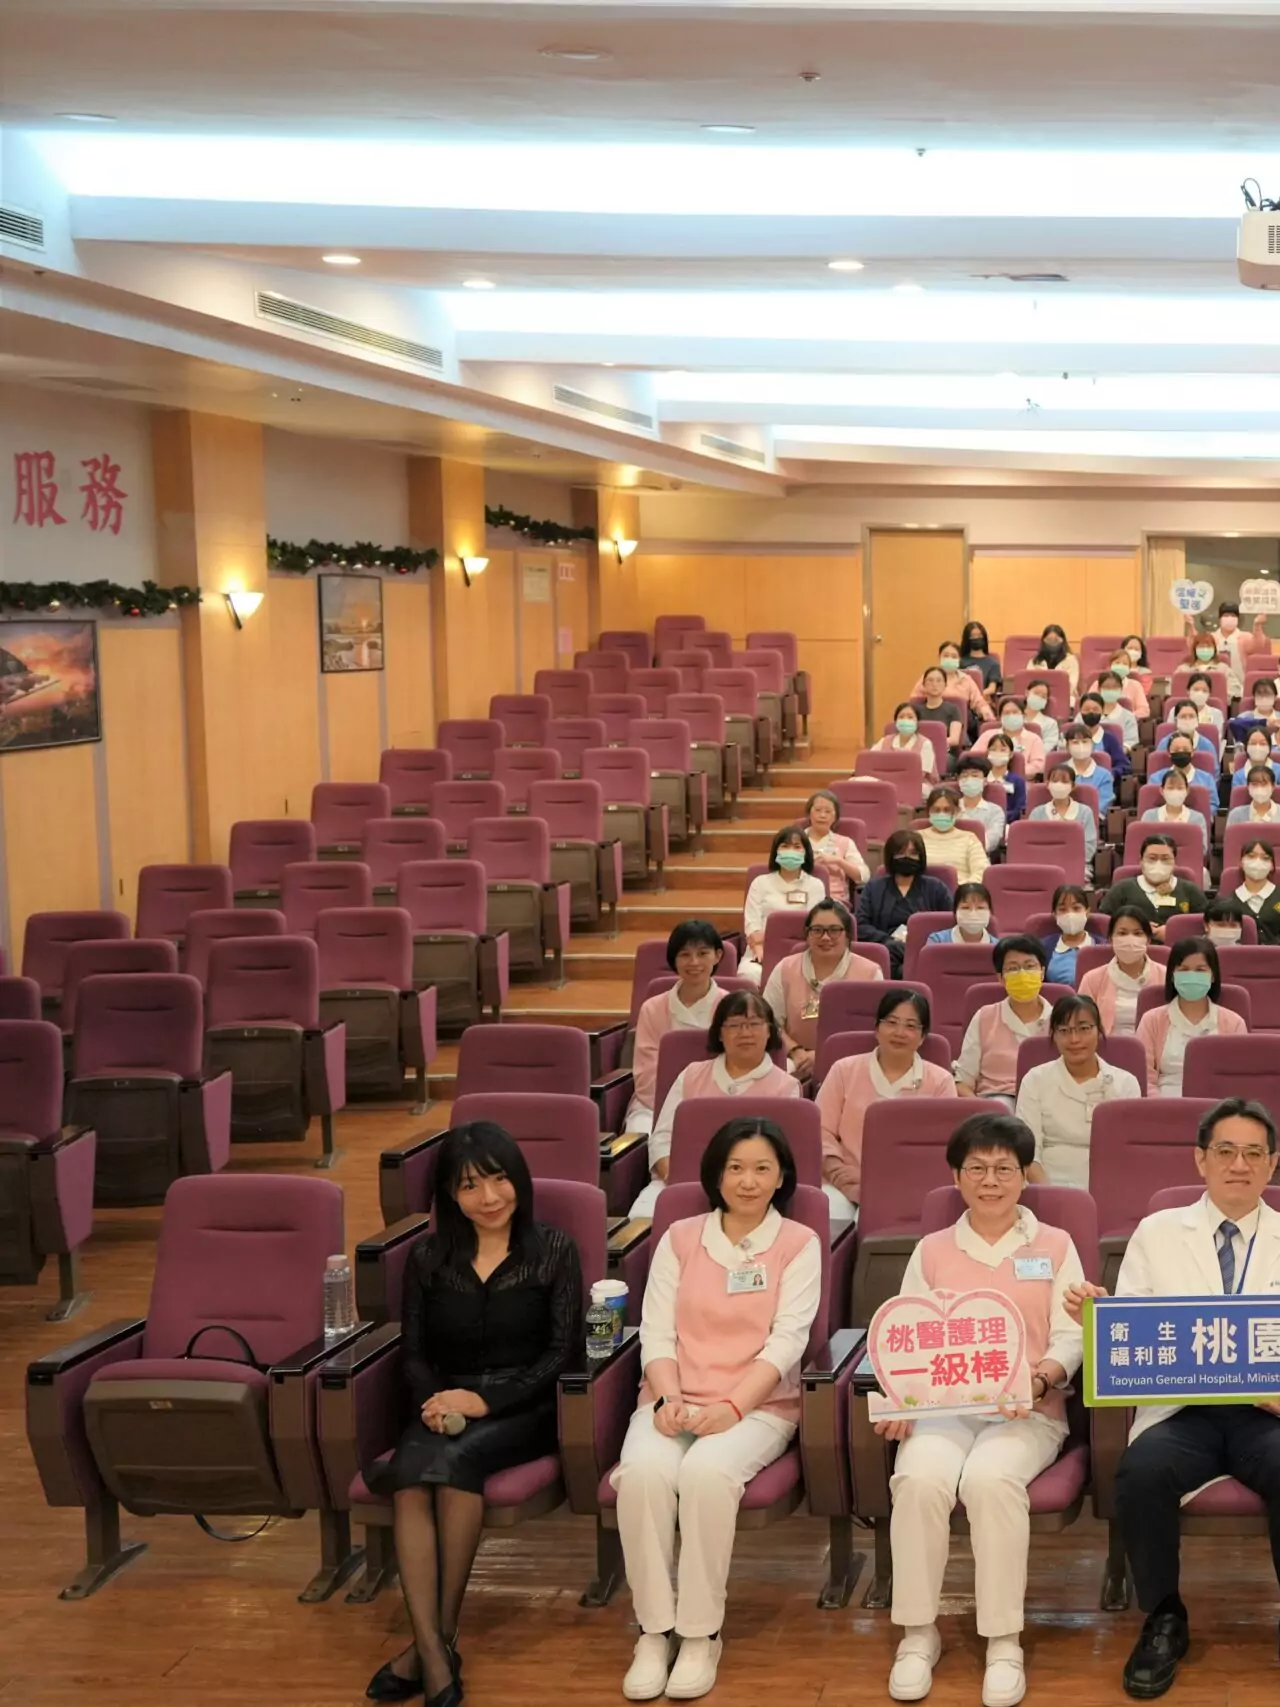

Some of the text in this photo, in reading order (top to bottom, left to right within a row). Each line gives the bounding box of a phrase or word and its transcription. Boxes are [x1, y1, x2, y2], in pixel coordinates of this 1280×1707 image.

[12, 451, 129, 536] 服務
[886, 1317, 1008, 1353] 桃醫護理
[1110, 1322, 1177, 1341] 衛生
[890, 1350, 1010, 1386] 一級棒
[1110, 1346, 1177, 1366] 福利部
[1110, 1375, 1153, 1387] Taoyuan
[1156, 1374, 1196, 1384] General
[1199, 1373, 1244, 1386] Hospital,
